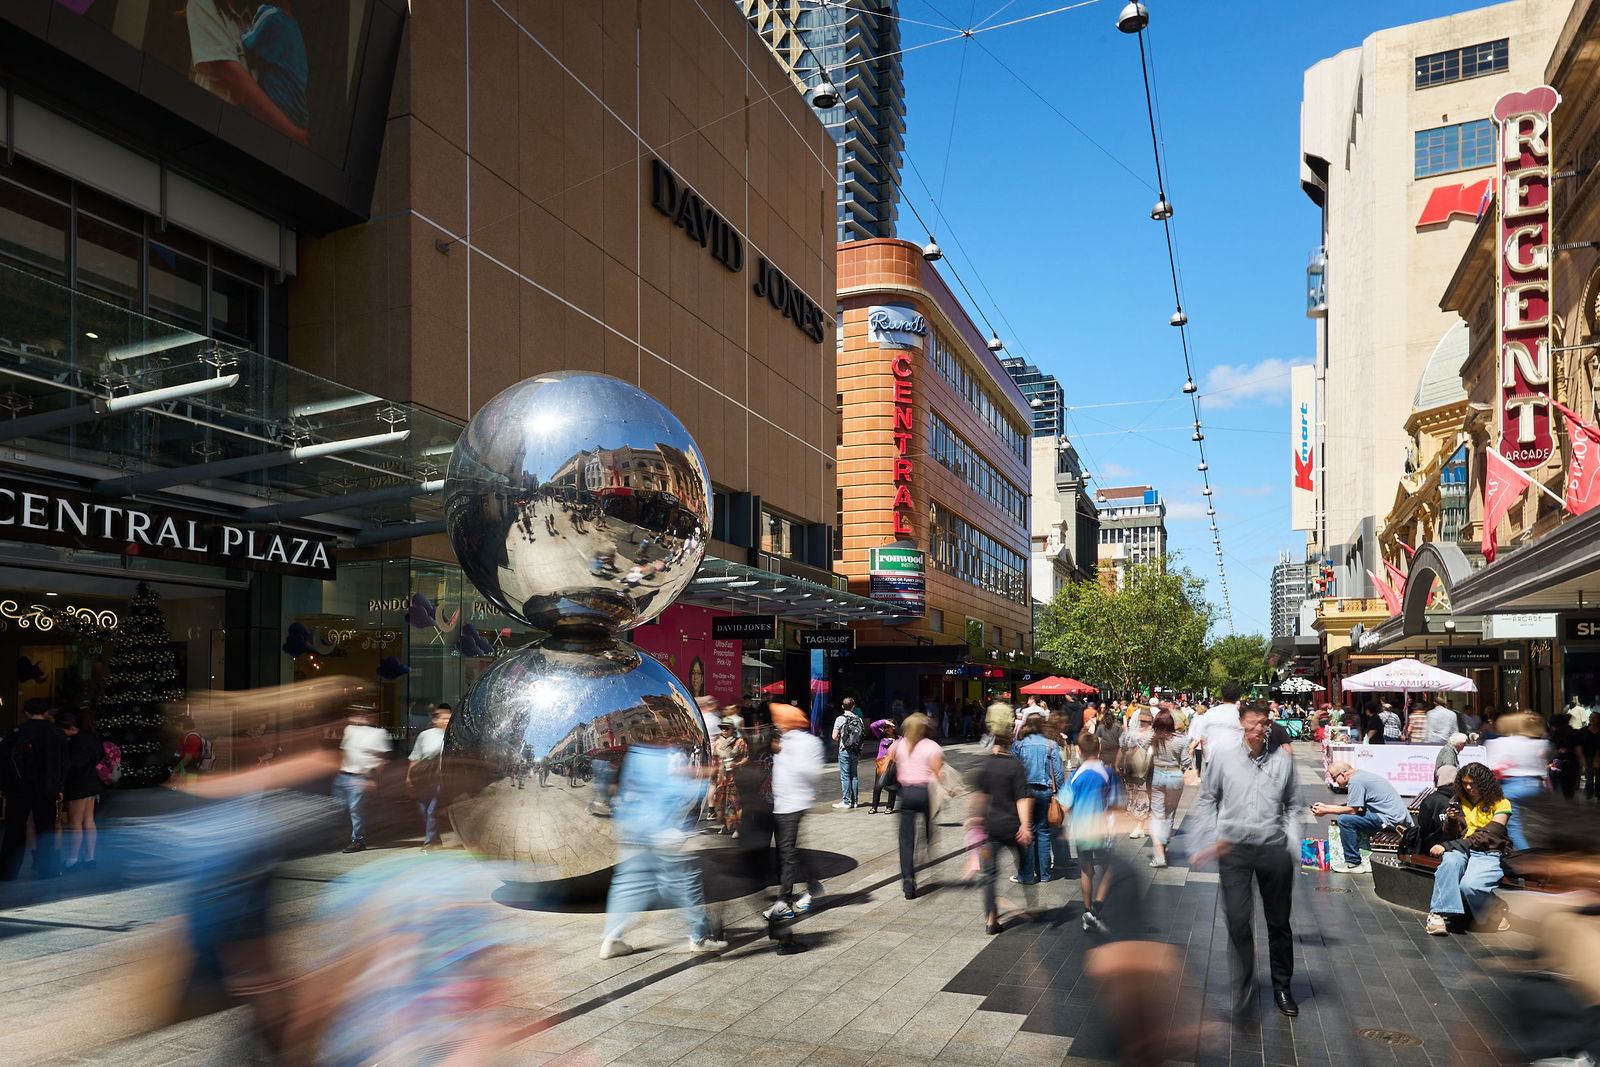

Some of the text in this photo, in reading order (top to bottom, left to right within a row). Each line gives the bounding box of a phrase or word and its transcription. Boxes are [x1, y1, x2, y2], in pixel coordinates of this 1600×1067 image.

[651, 158, 824, 344] DAVID JONES
[1503, 112, 1549, 444] REGENT
[892, 354, 913, 535] CENTRAL
[1295, 402, 1313, 492] Kmart
[1505, 448, 1549, 461] ARCADE
[223, 525, 331, 569] PLAZA
[717, 623, 772, 632] DAVID JONES
